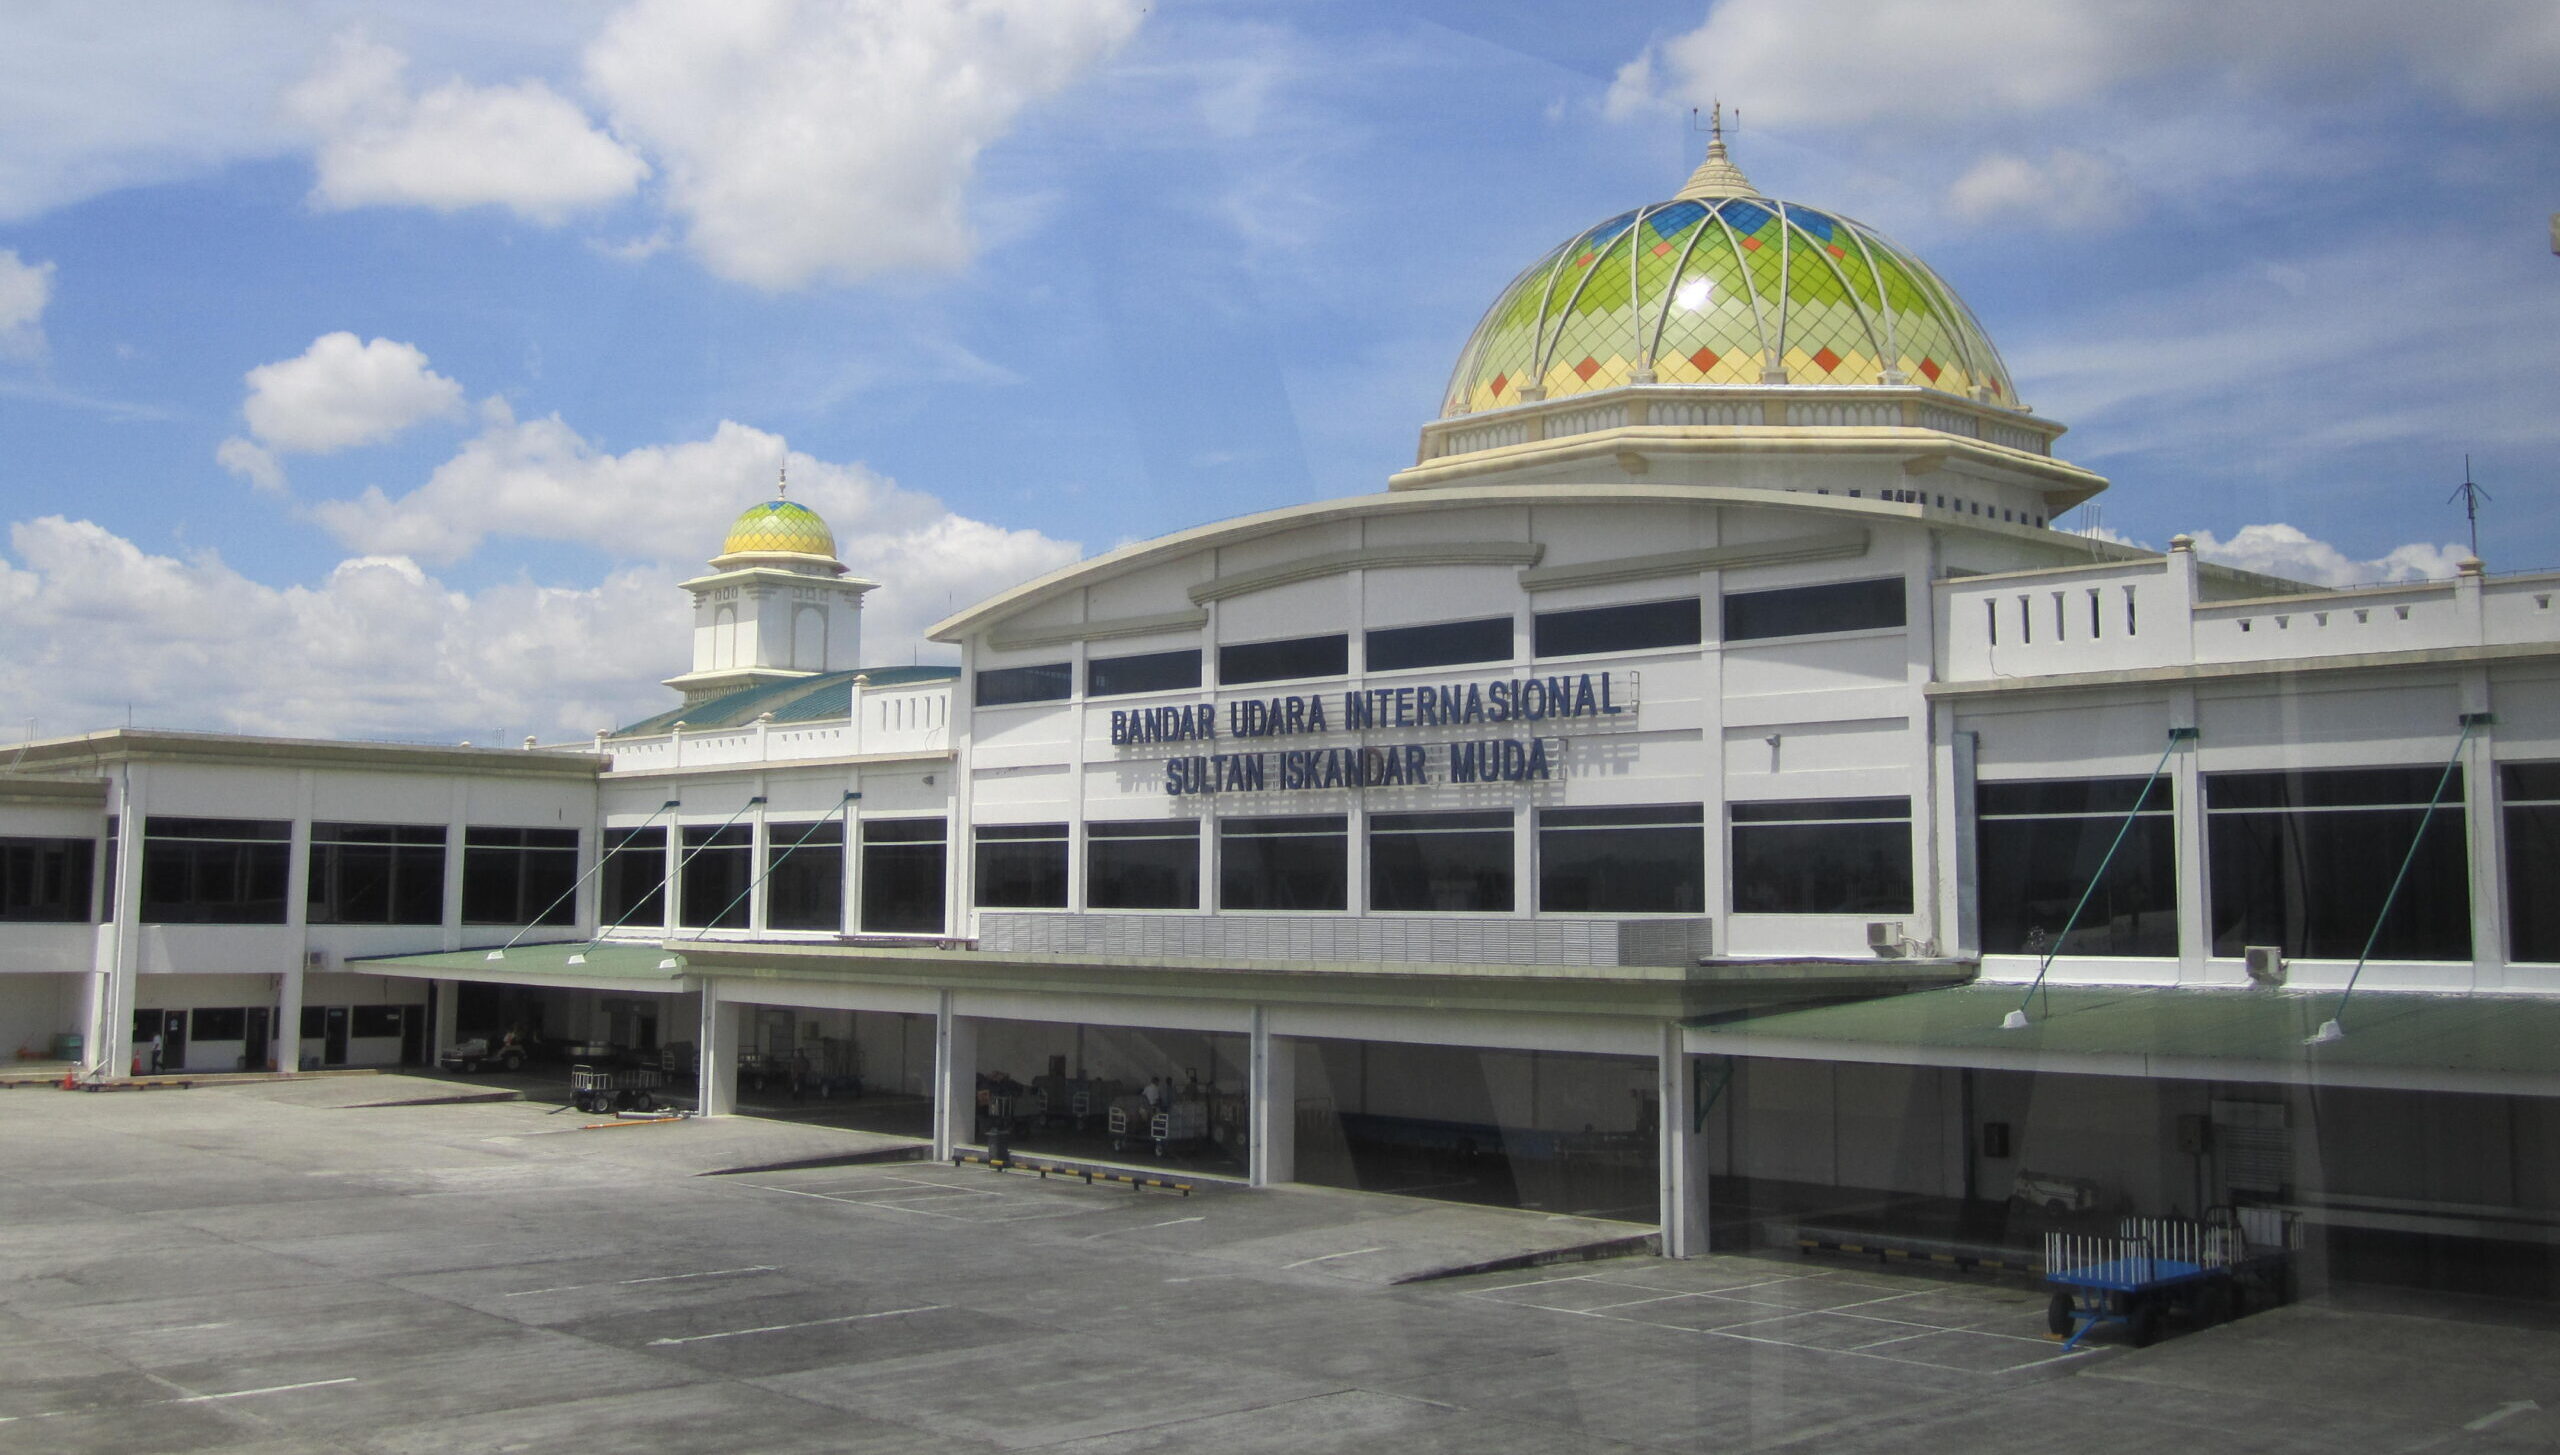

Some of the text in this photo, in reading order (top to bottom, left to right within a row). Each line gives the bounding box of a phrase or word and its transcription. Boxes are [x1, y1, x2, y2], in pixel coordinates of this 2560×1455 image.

[1111, 672, 1622, 745] BANDAR UDARA INTERNASIONAL
[1166, 738, 1549, 796] SULTAN ISKANDAR MUDA
